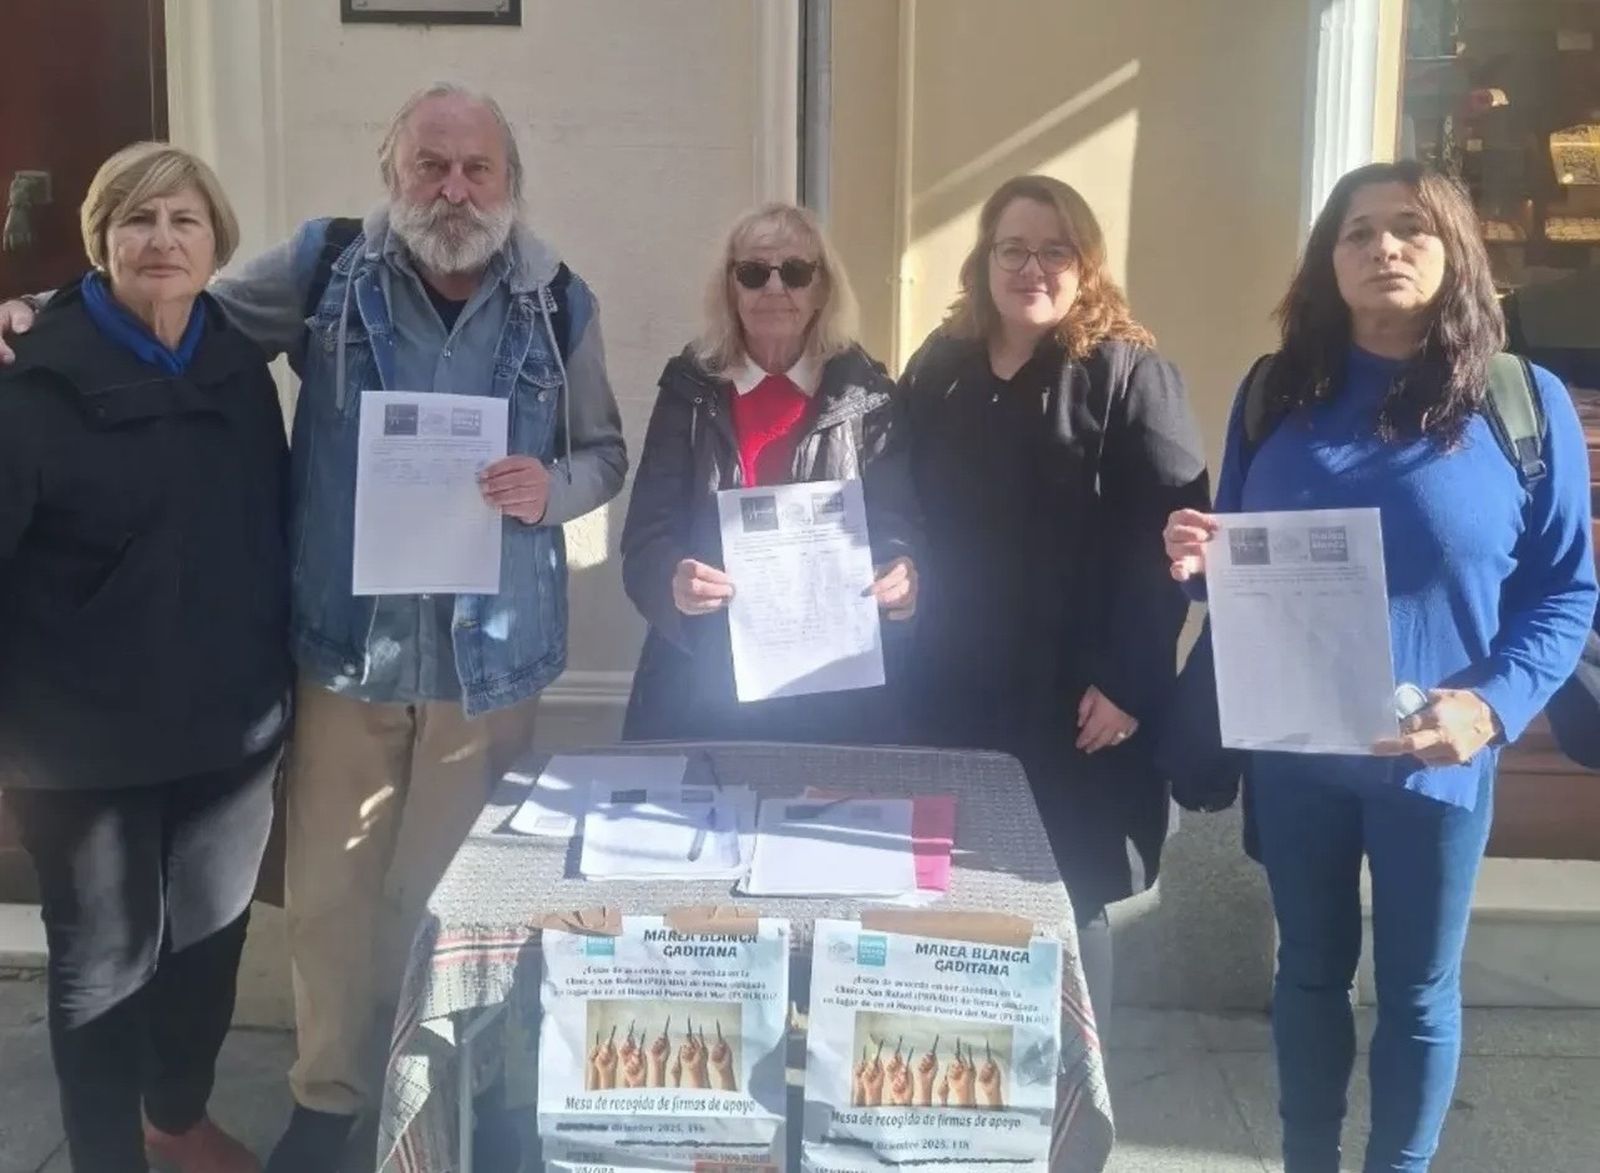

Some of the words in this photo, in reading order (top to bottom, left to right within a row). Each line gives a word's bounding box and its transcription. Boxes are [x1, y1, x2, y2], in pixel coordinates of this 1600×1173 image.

[663, 945, 738, 958] GADITANA
[915, 943, 967, 958] MAREA
[971, 947, 1031, 964] BLANCA
[934, 959, 1010, 976] GADITANA
[565, 1095, 593, 1110] Mesa
[595, 1096, 608, 1110] de
[610, 1096, 655, 1115] recogida
[657, 1096, 670, 1110] de
[672, 1095, 706, 1113] firmas
[708, 1096, 721, 1111] de
[723, 1099, 756, 1116] apoyo
[831, 1111, 858, 1124] Mesa
[860, 1112, 873, 1125] de
[875, 1113, 921, 1129] recogida
[922, 1114, 935, 1126] de
[937, 1114, 973, 1128] firmas
[974, 1115, 987, 1127] de
[988, 1116, 1021, 1131] apoyo
